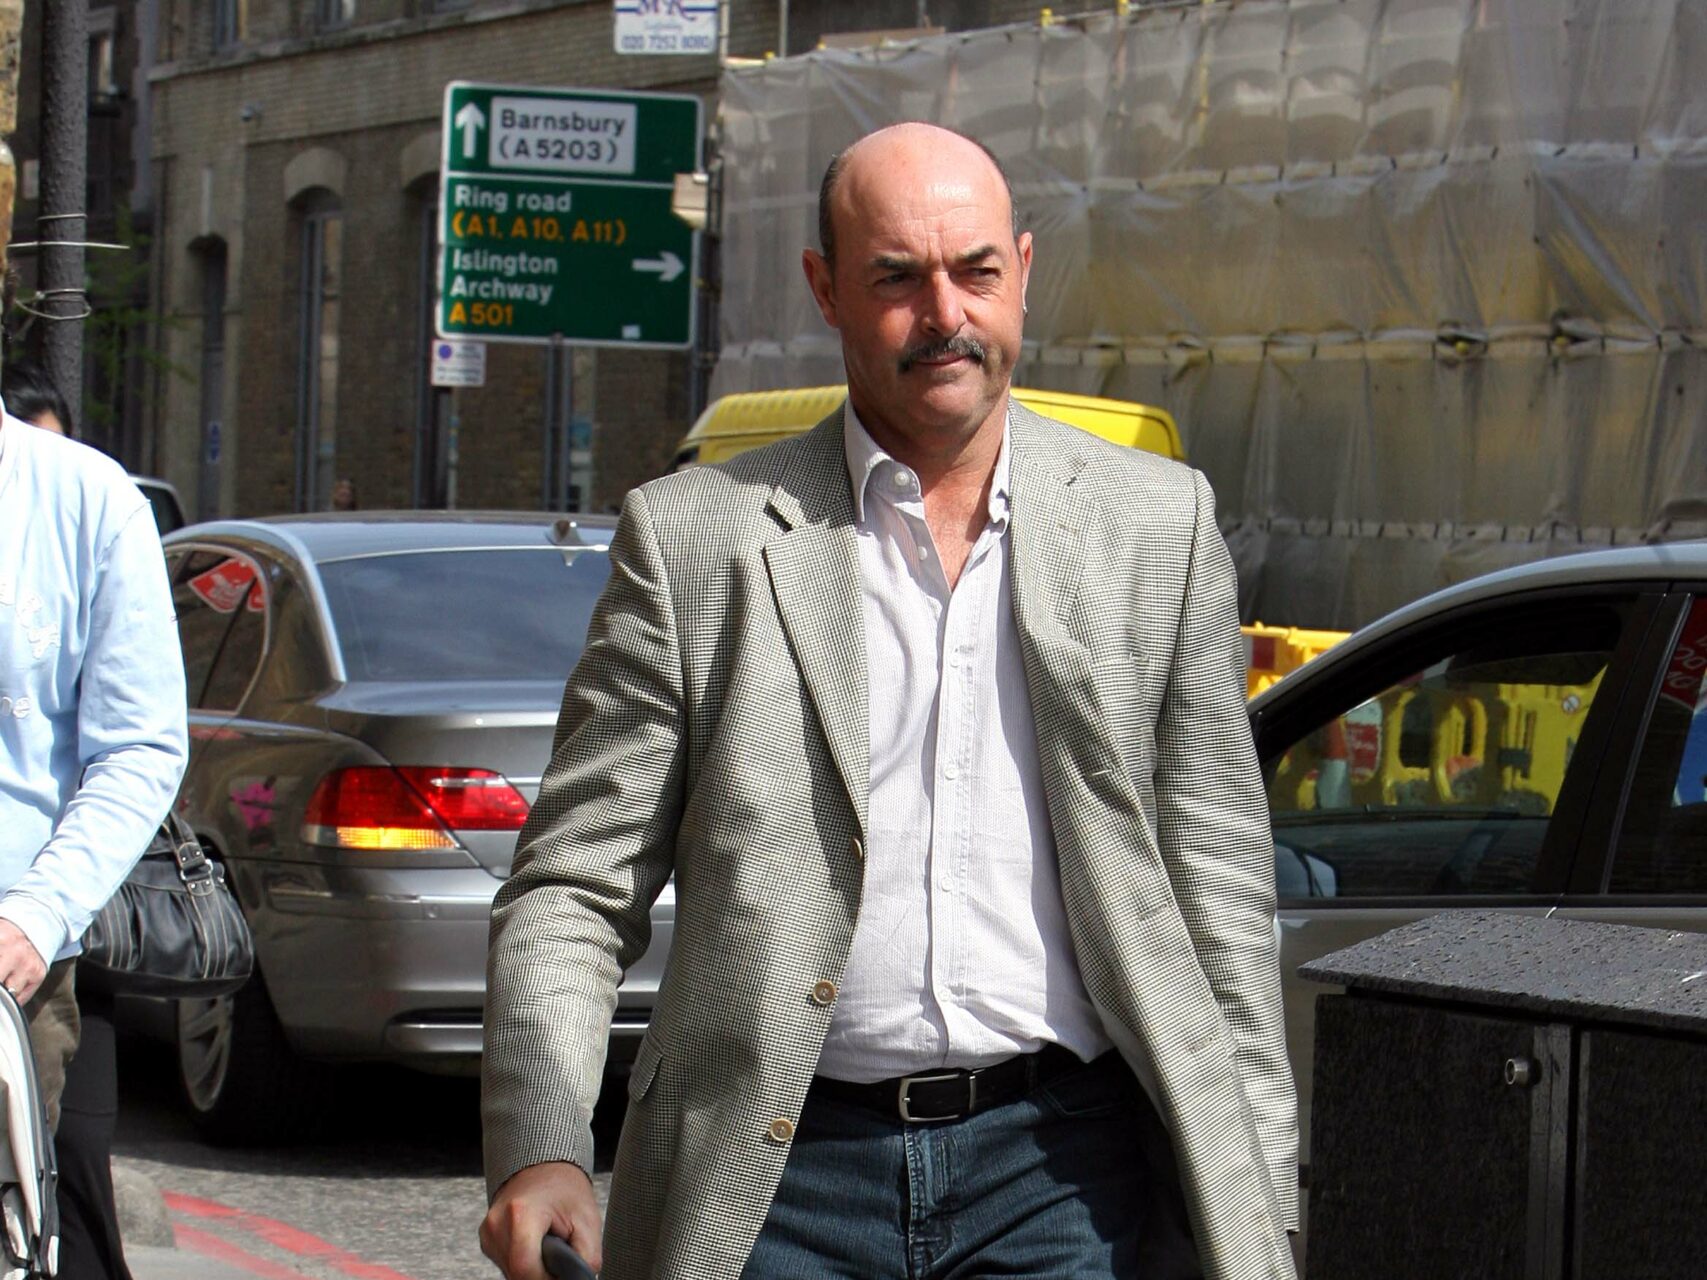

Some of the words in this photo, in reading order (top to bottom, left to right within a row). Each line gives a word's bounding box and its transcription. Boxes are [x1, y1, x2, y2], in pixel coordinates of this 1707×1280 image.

[501, 108, 626, 137] Barnsbury
[499, 135, 619, 163] (A5203)
[454, 184, 509, 213] Ring
[516, 190, 572, 212] road
[571, 219, 627, 245] A11)
[453, 248, 558, 276] Islington
[450, 275, 554, 305] Archway
[449, 302, 514, 326] A501
